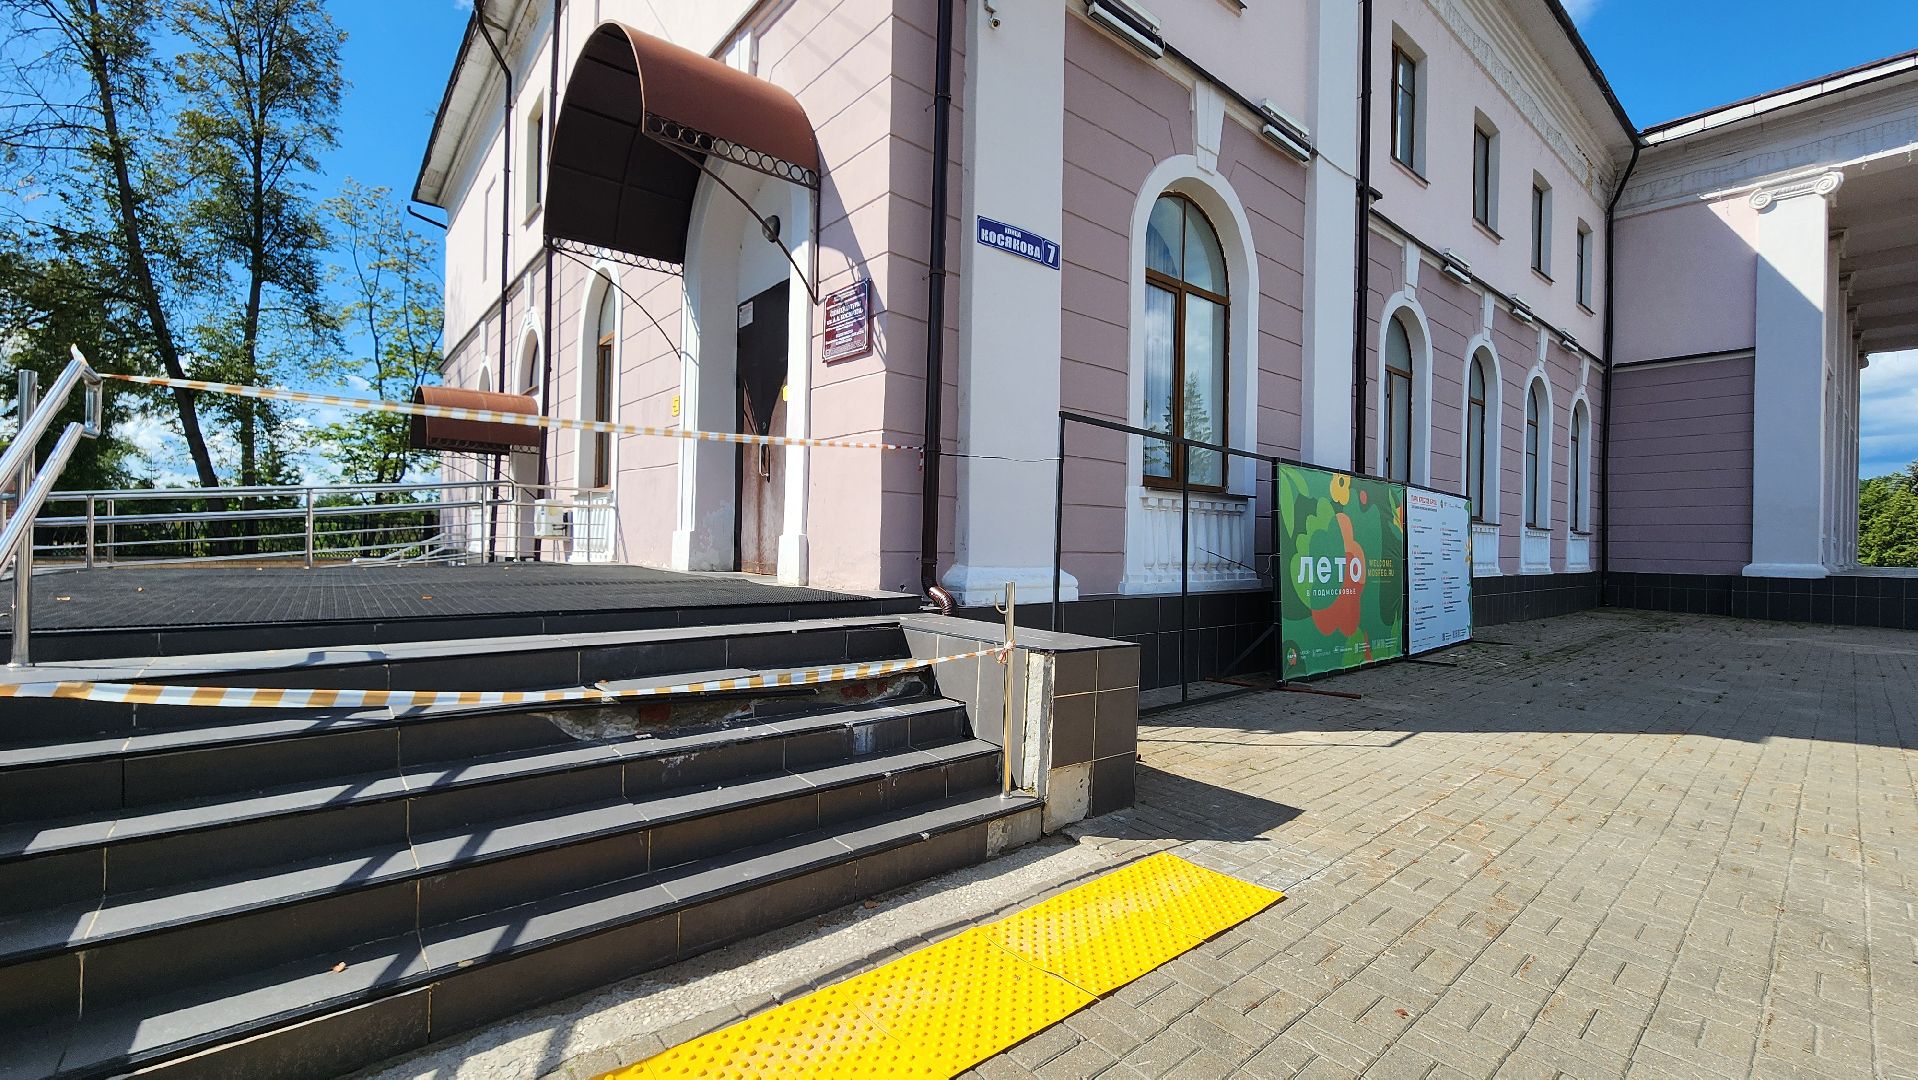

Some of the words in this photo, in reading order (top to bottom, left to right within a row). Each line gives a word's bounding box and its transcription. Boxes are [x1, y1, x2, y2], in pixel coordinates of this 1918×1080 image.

[981, 228, 1041, 259] КОСЯКОВА
[1047, 244, 1056, 264] 7
[1367, 568, 1395, 577] MOSREG.RU
[1312, 588, 1357, 596] ПОДМОСКОВЬЕ
